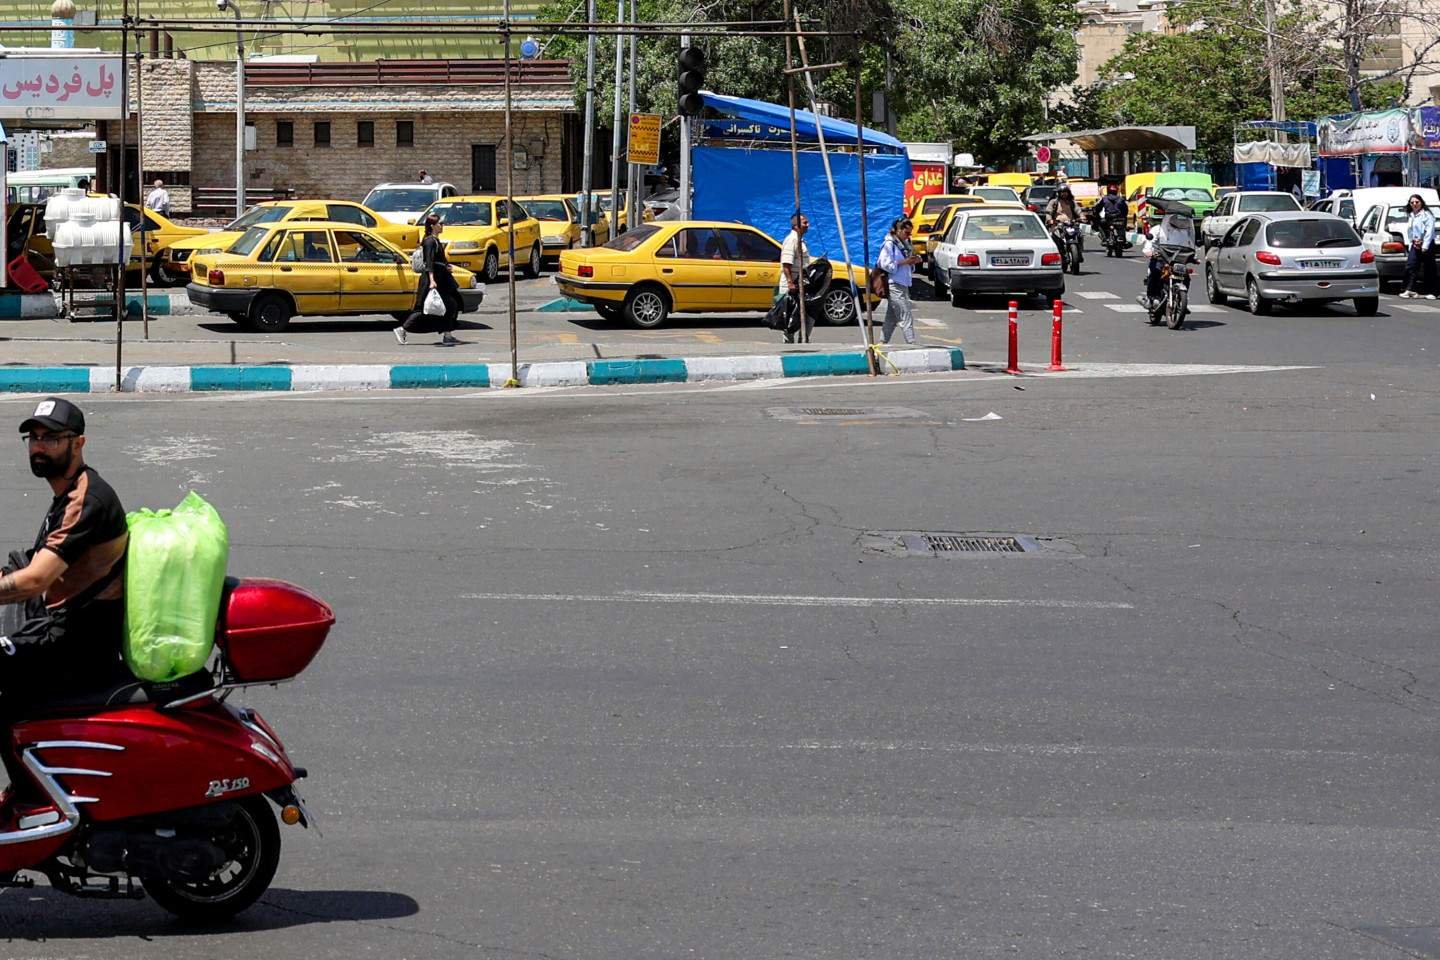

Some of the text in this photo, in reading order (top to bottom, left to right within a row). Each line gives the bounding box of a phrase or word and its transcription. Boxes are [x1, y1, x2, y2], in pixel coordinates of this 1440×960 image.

[2, 65, 83, 102] فردیس
[86, 63, 115, 98] پل
[231, 777, 250, 790] 150
